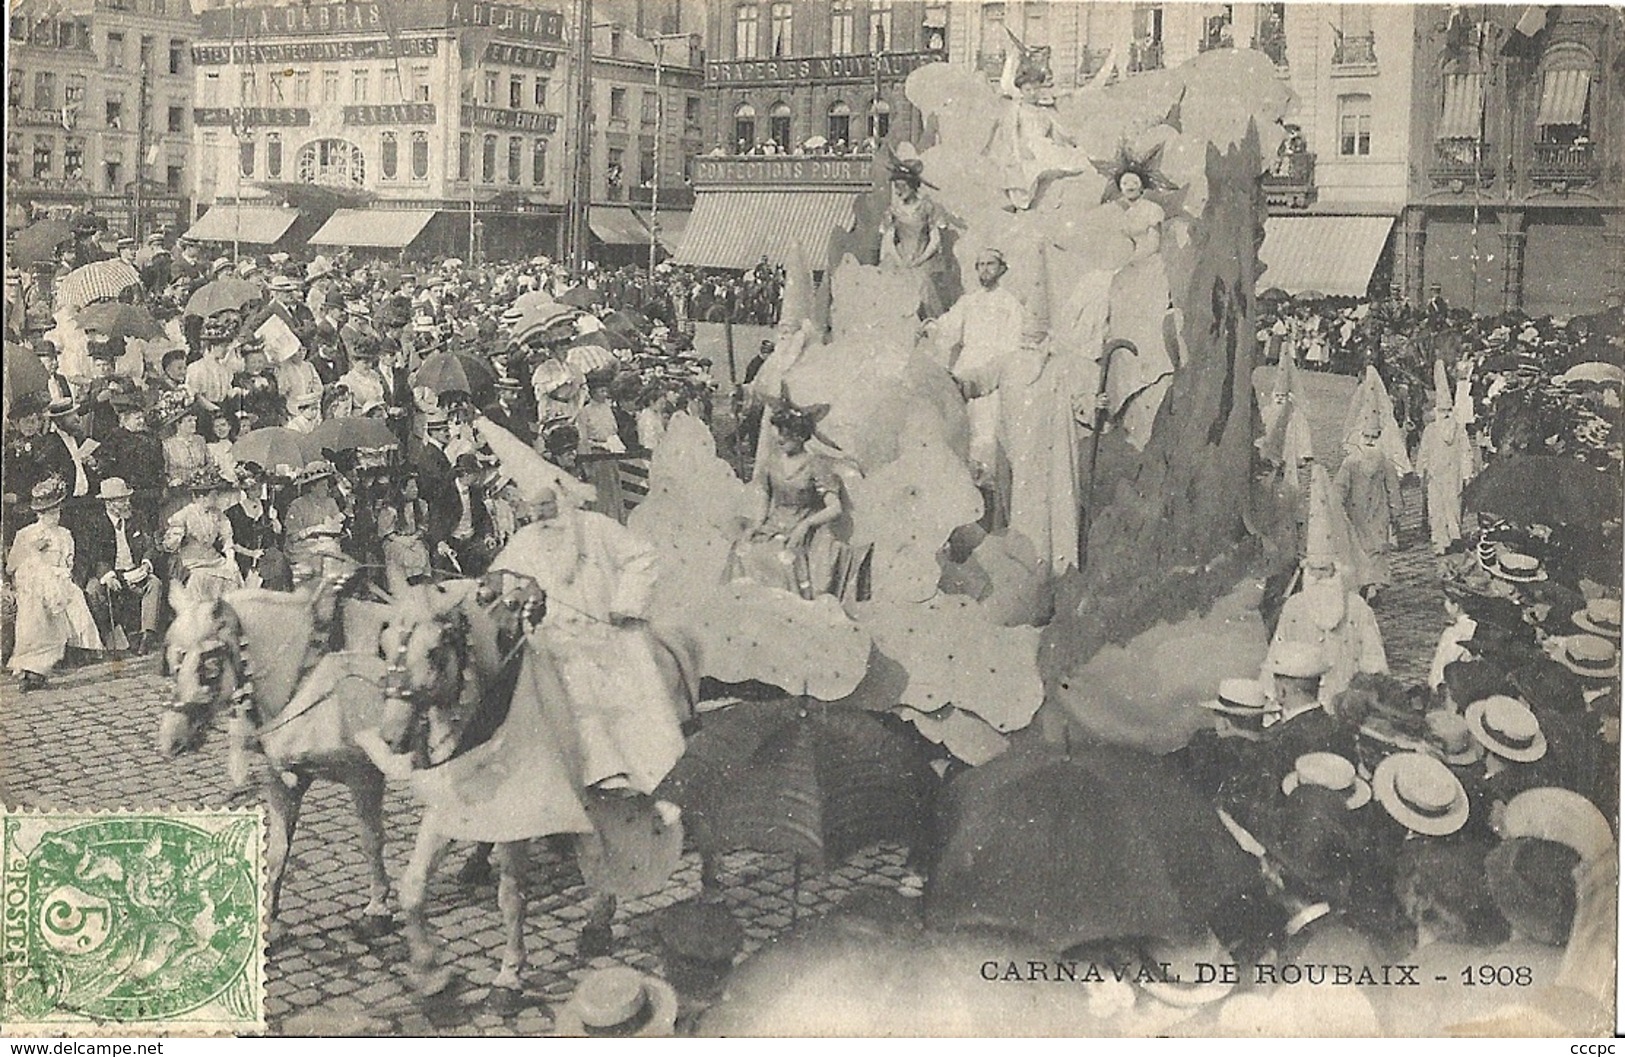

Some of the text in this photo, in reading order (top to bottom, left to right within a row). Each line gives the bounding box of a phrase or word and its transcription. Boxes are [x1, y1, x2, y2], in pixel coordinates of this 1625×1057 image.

[286, 4, 380, 29] DEBRAS
[474, 4, 557, 35] DEBRAS
[697, 161, 803, 180] CONFECTIONS
[811, 161, 851, 180] POUR
[6, 874, 29, 964] POSTES
